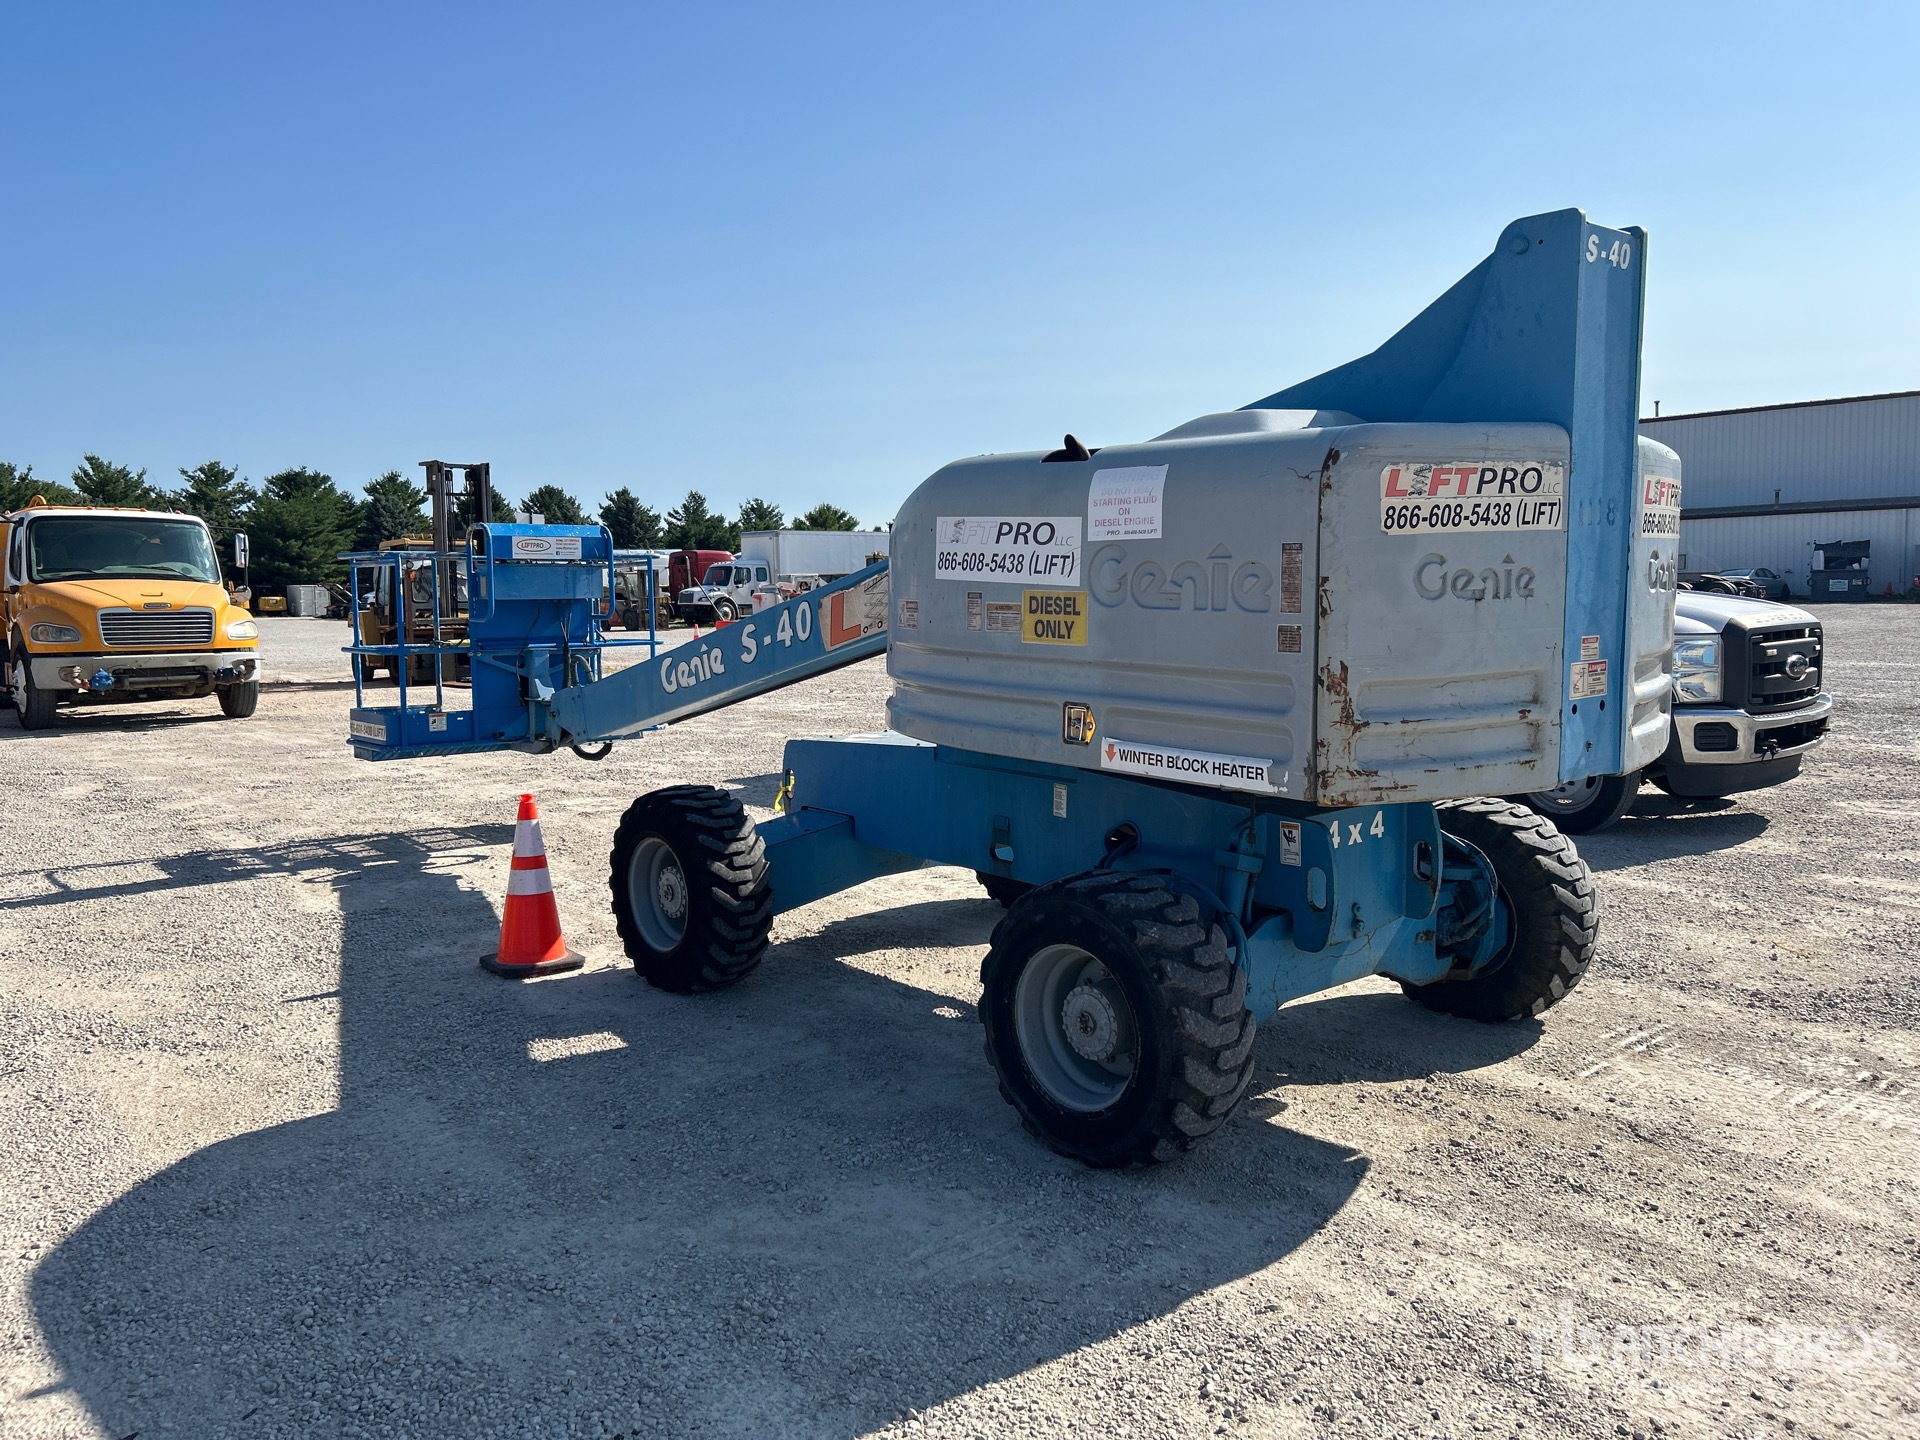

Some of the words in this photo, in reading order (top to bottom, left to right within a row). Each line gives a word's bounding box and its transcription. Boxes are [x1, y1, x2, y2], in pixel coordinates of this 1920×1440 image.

[1115, 487, 1131, 496] NOT
[1542, 482, 1560, 494] LLC
[1092, 496, 1132, 507] STARTING
[1133, 495, 1158, 504] FLUID
[1094, 519, 1122, 527] DIESEL
[1124, 516, 1155, 526] ENGINE
[1118, 507, 1131, 516] ON
[1383, 502, 1511, 530] 866-608-5438
[1516, 498, 1562, 528] (LIFT)
[1055, 535, 1074, 547] LLC
[938, 552, 1025, 575] 866-608-5438
[1029, 551, 1076, 577] (LIFT)
[1088, 542, 1273, 613] Genie
[1413, 552, 1536, 600] Genie
[1029, 596, 1081, 616] DIESEL
[1034, 619, 1075, 639] ONLY
[660, 643, 725, 694] Genie
[1118, 748, 1164, 768] WINTER
[1166, 754, 1209, 774] BLOCK
[1211, 761, 1265, 781] HEATER
